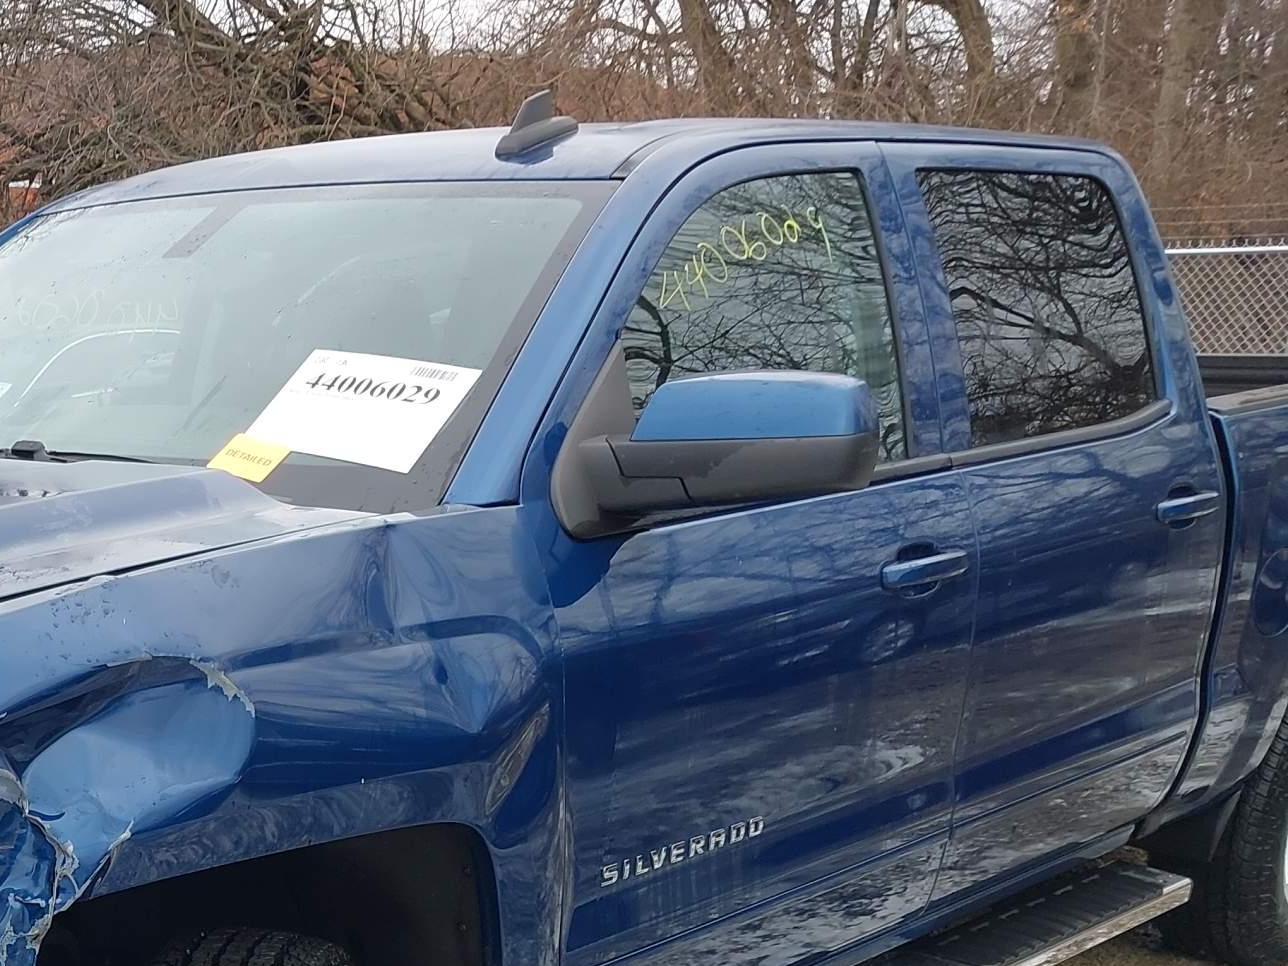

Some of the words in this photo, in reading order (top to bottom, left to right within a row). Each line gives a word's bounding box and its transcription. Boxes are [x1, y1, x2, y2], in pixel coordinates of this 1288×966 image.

[306, 372, 441, 405] 44006029
[224, 448, 273, 467] DETAILED
[600, 816, 765, 888] SILVERADO
